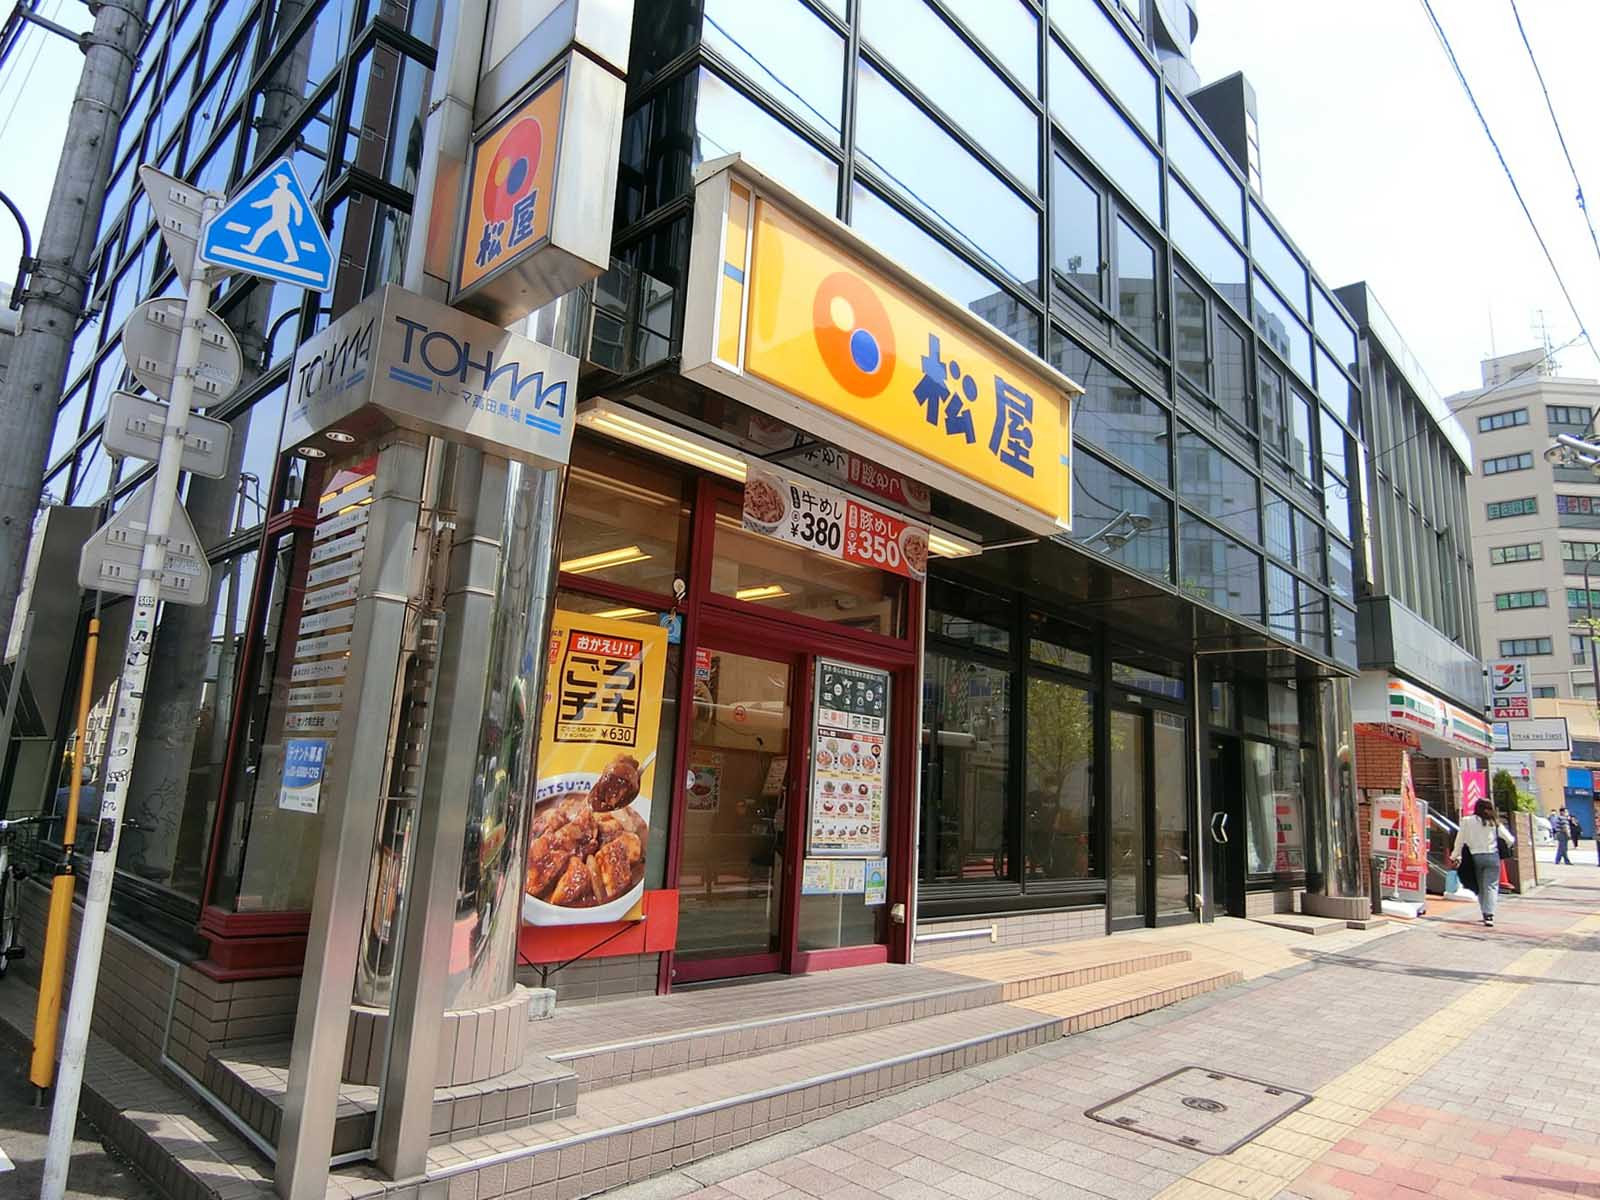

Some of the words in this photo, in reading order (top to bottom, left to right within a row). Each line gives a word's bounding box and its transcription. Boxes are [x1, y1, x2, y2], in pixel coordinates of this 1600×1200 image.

[474, 189, 538, 267] 松屋
[395, 315, 568, 418] TOHMA
[913, 332, 1034, 479] 松屋
[801, 490, 843, 520] 牛めし
[790, 512, 841, 550] ¥380
[860, 510, 898, 539] 豚めし
[847, 531, 900, 568] ¥350
[576, 635, 634, 657] おかえり!!
[1498, 709, 1526, 718] ATM
[601, 727, 631, 741] ¥630
[537, 780, 592, 799] ATSUYA
